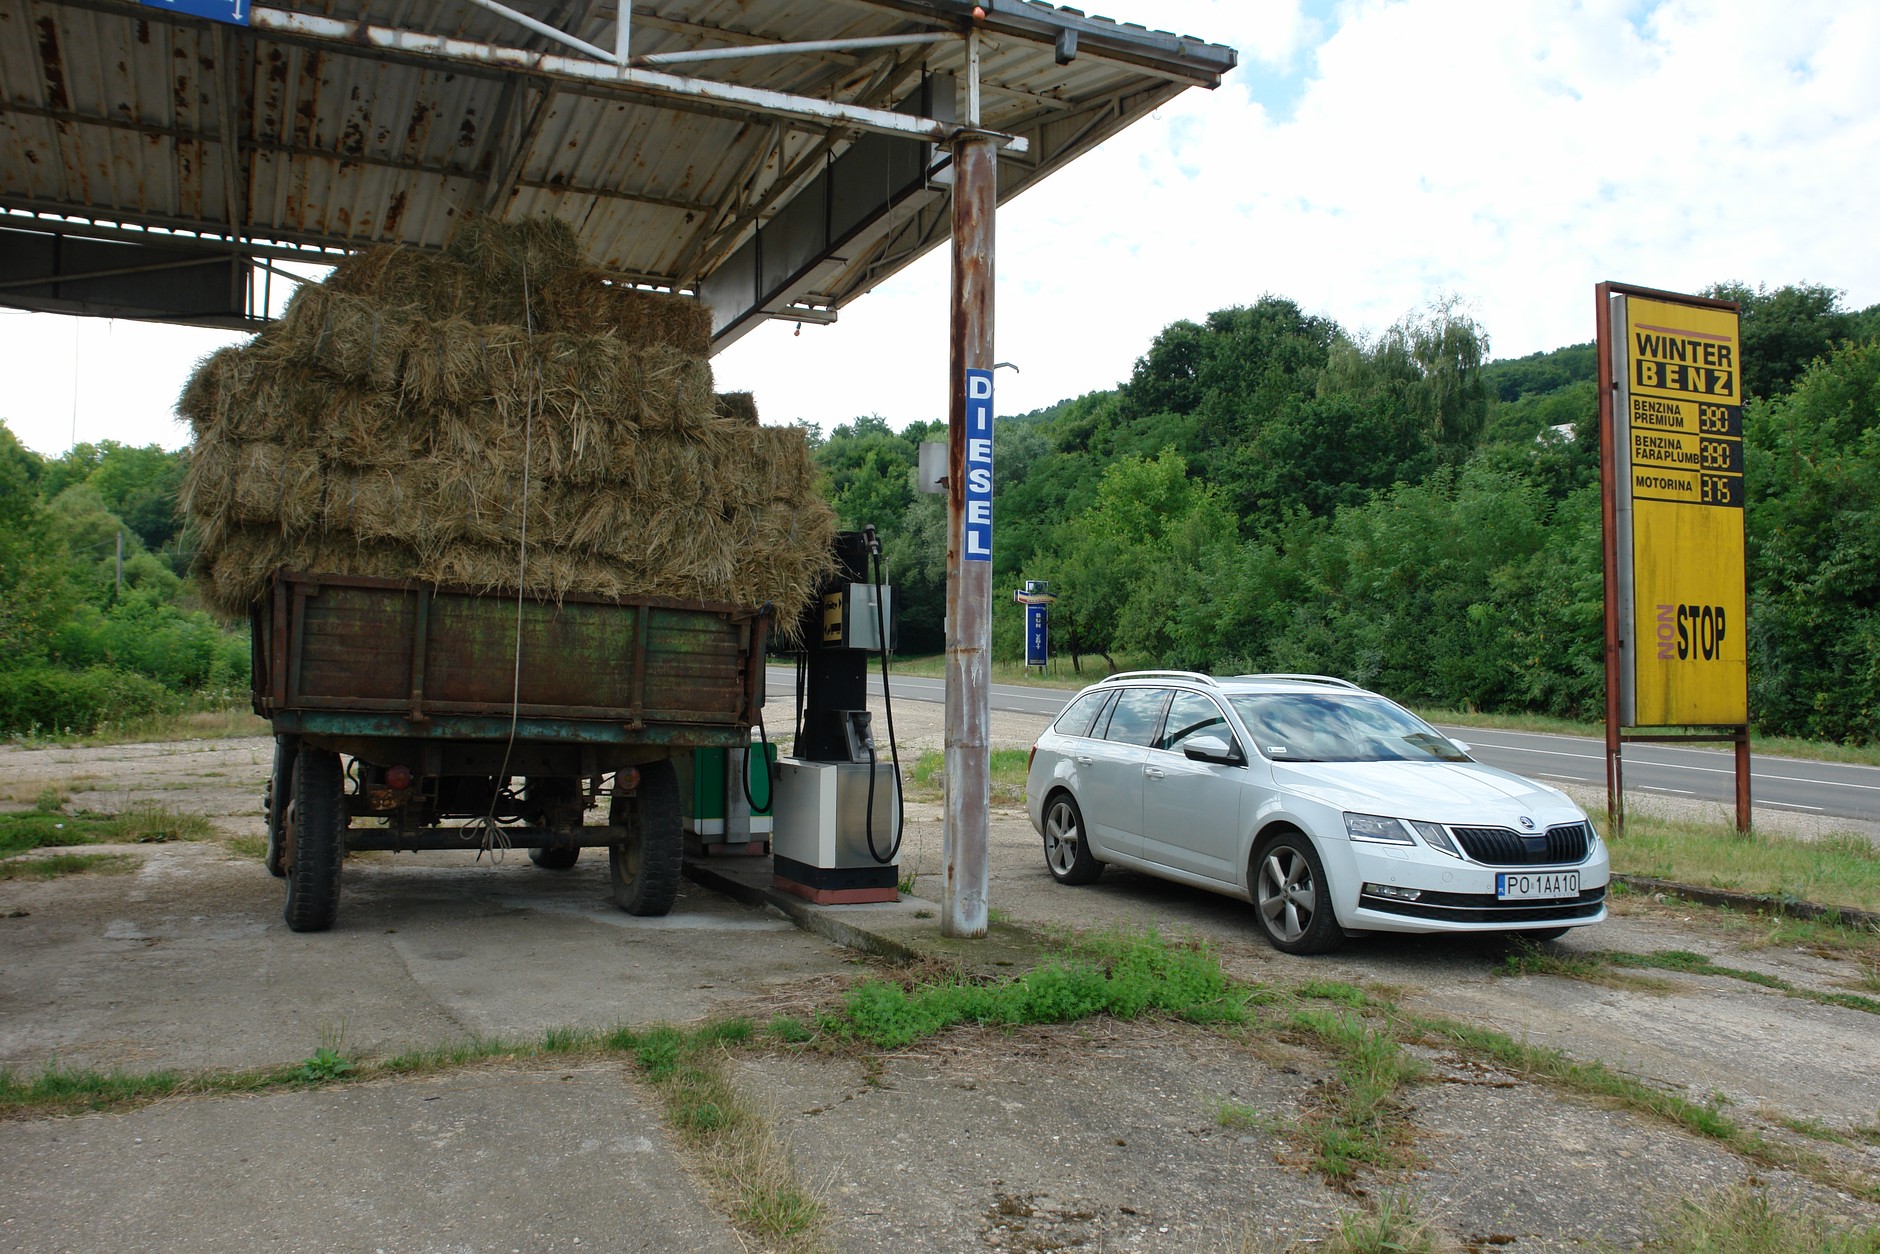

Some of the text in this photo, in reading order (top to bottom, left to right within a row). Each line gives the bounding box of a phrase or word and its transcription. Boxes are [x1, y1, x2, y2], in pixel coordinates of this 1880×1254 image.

[1636, 332, 1732, 368] WINTER
[1641, 361, 1730, 395] BENZ
[1634, 399, 1681, 415] BENZINA
[1634, 411, 1684, 428] PREMIUM
[1635, 435, 1682, 450] BENZINA
[1636, 447, 1700, 464] FARAPLUMB
[967, 376, 992, 555] DIESEL
[1636, 475, 1693, 492] MOTORINA
[1657, 604, 1726, 661] NON STOP
[1508, 875, 1576, 894] PO 1AA10
